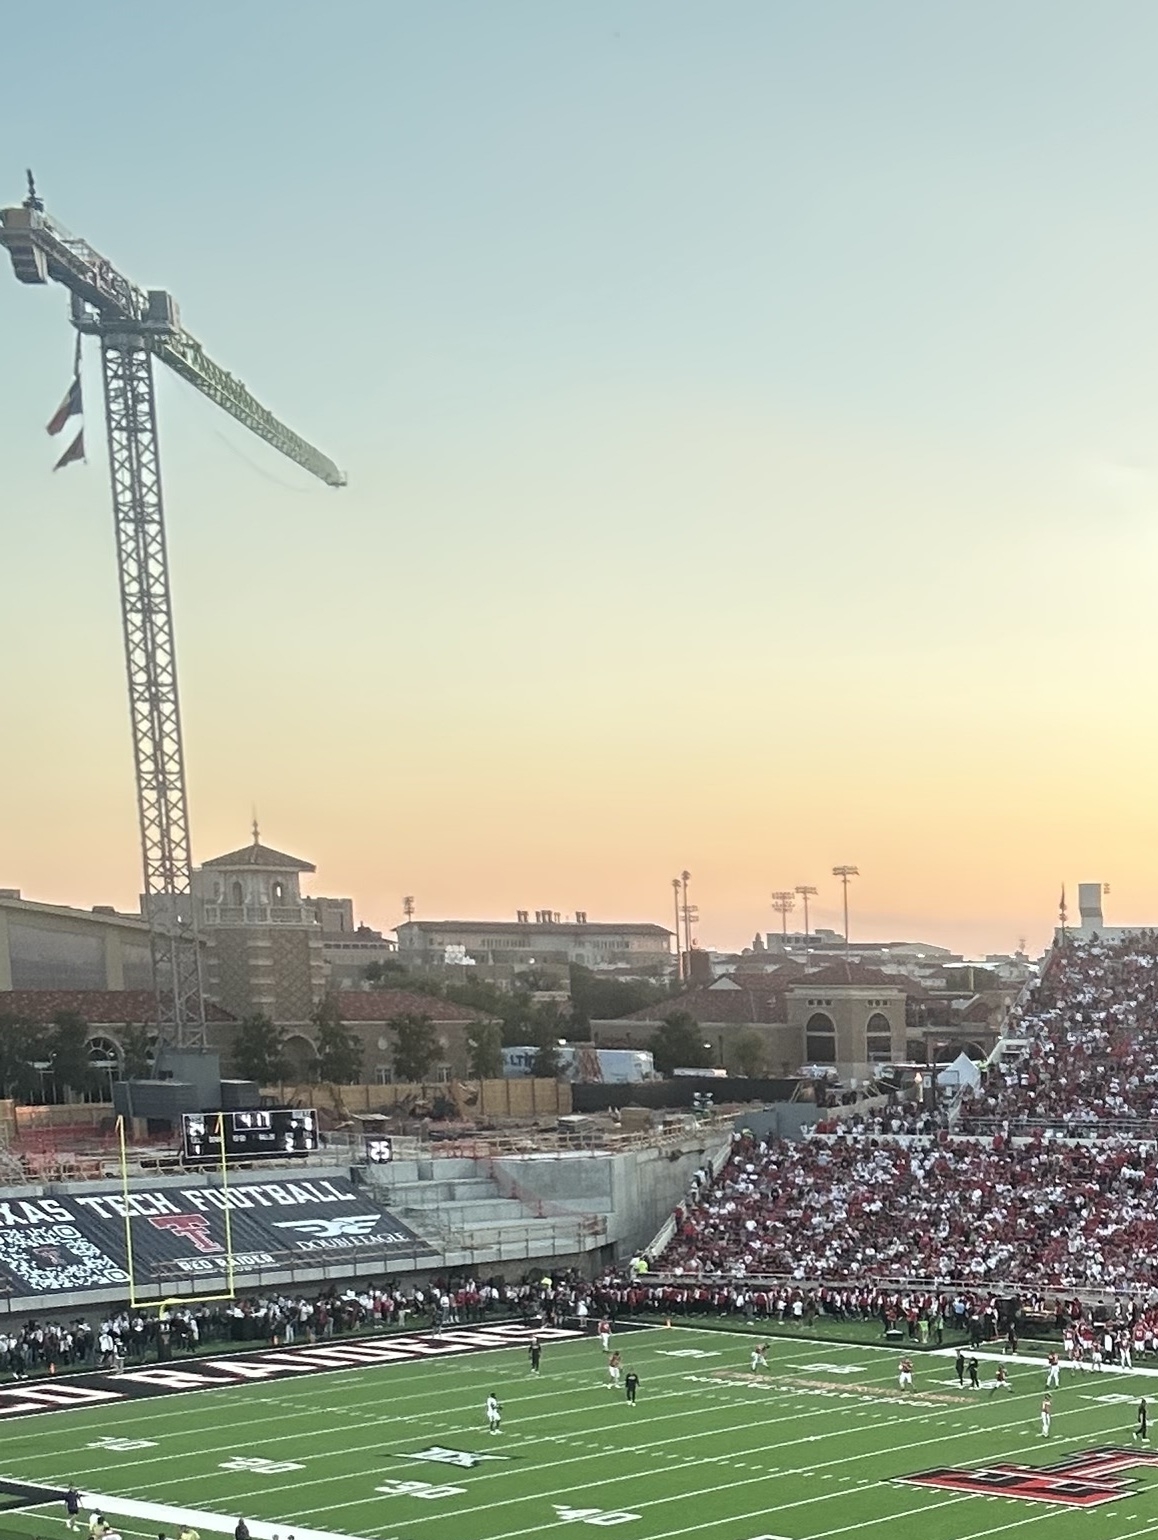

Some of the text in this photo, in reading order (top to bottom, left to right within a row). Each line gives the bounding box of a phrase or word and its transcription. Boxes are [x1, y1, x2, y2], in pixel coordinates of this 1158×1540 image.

[368, 1140, 390, 1161] 25
[75, 1192, 182, 1219] TECH
[181, 1181, 357, 1212] FOOTBALL
[177, 1260, 213, 1271] RED
[106, 1324, 586, 1388] RAIDERS
[218, 1456, 307, 1474] 20
[374, 1480, 468, 1499] 30
[555, 1505, 642, 1526] 40
